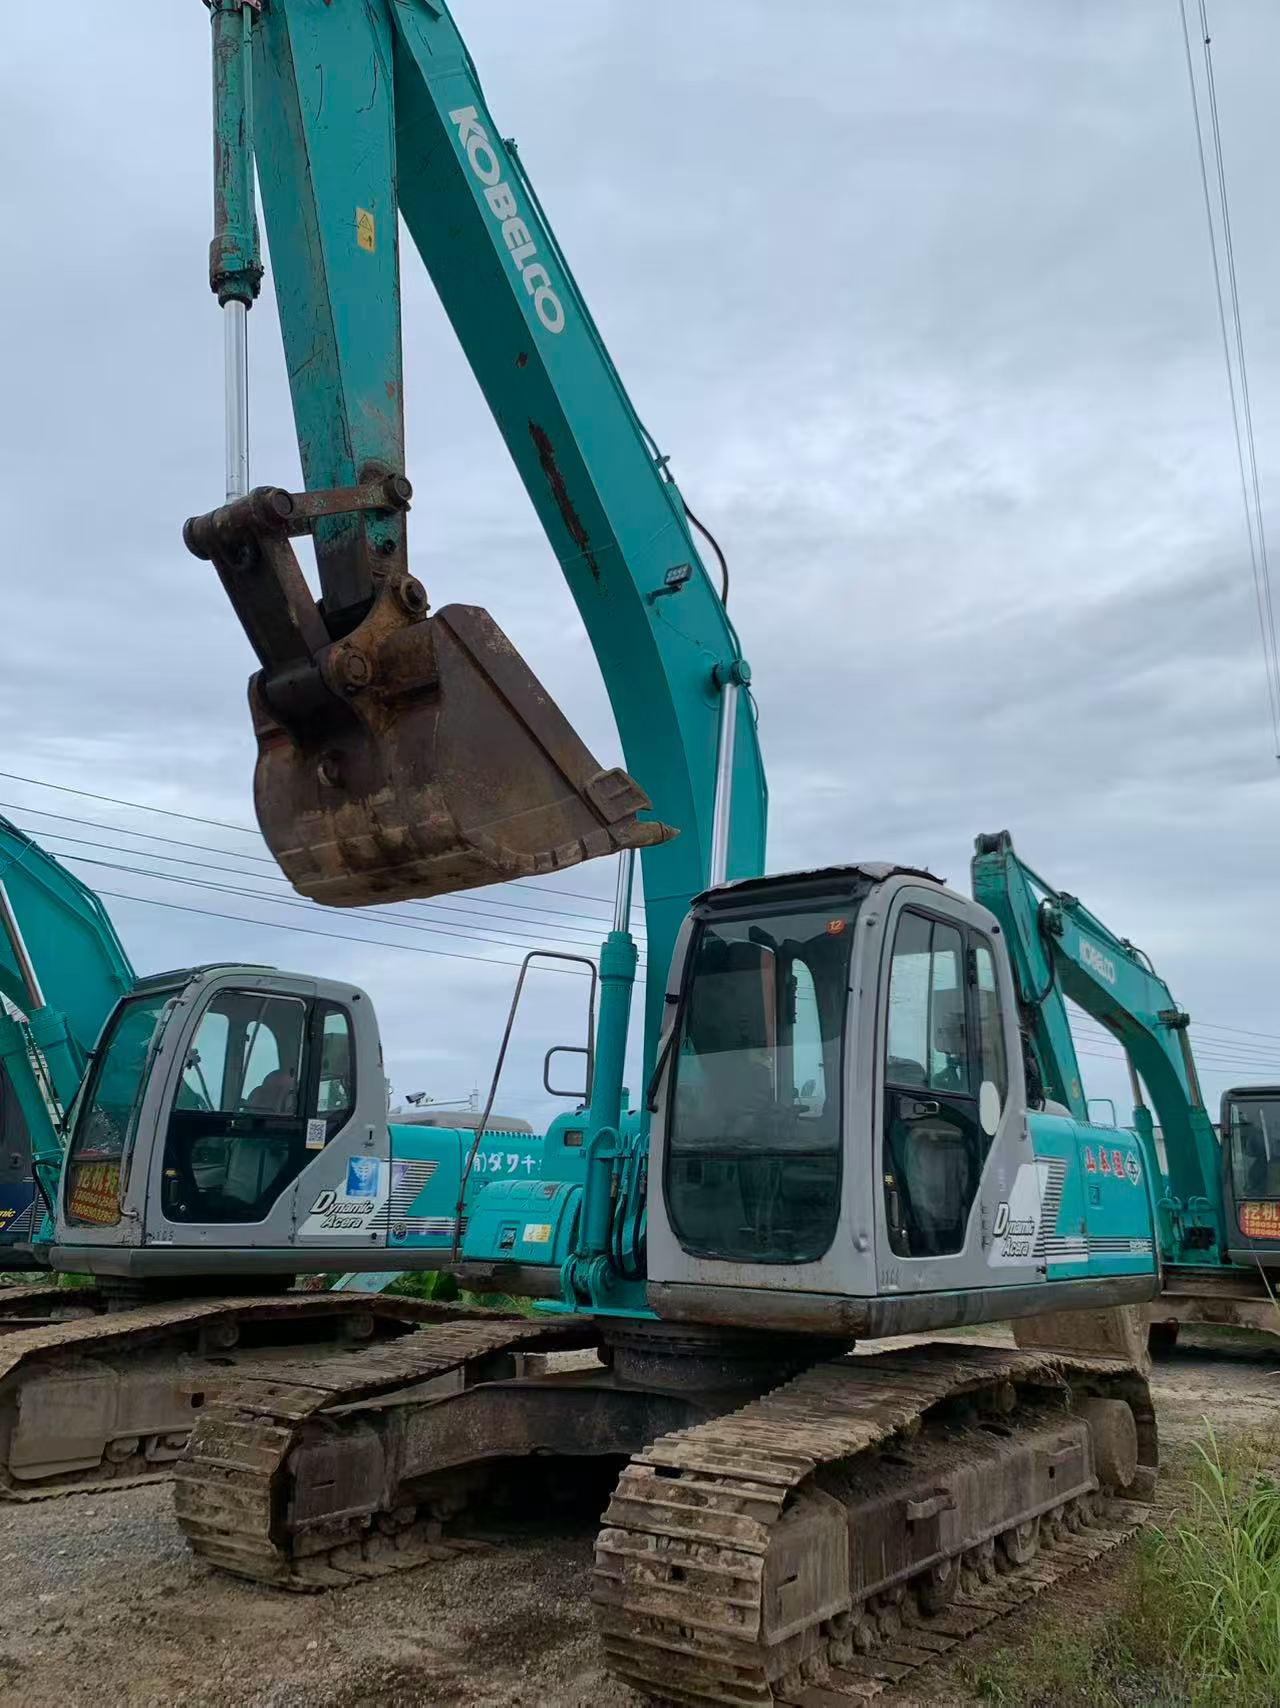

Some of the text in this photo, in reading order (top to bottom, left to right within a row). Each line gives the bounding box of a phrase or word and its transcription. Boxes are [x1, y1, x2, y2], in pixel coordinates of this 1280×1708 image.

[448, 105, 565, 334] KOBELCO
[309, 1189, 375, 1217] Dynamic
[320, 1214, 363, 1229] Acera
[992, 1201, 1035, 1239] Dynamic
[1002, 1237, 1030, 1257] Acera
